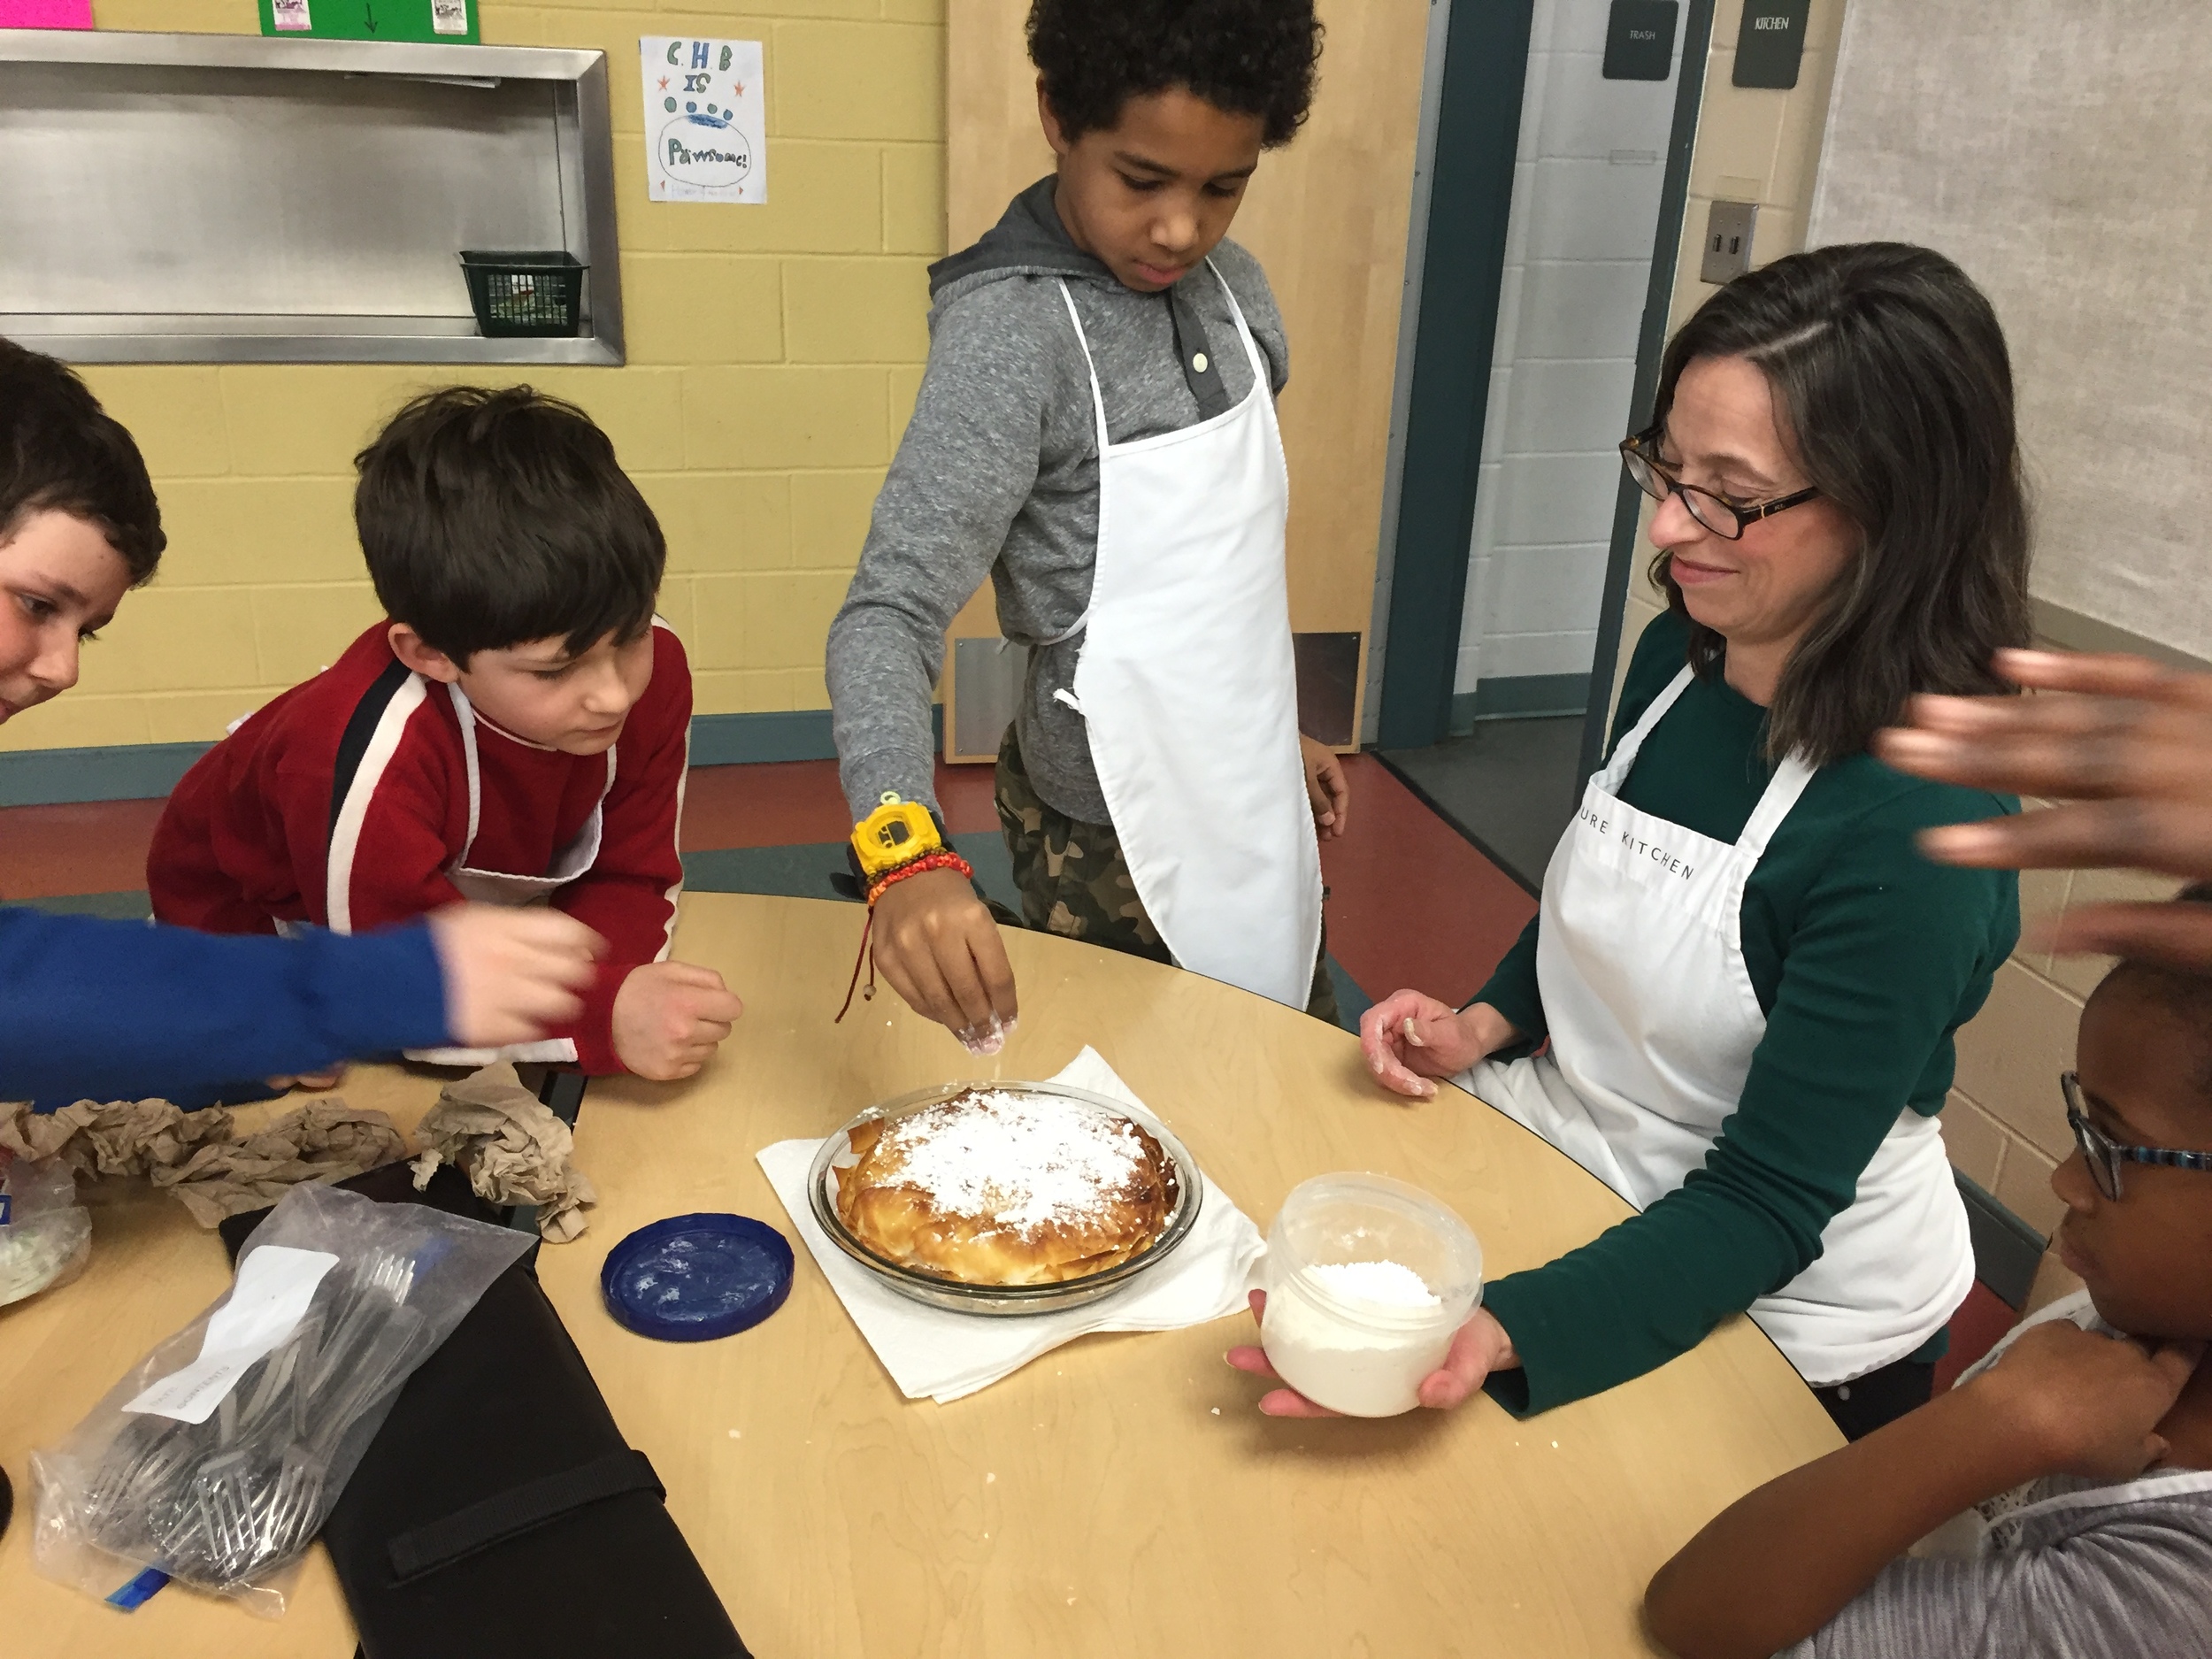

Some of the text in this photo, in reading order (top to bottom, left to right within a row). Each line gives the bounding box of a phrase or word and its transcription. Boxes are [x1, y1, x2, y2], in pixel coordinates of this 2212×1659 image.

[1755, 17, 1789, 30] KITCHEN
[1630, 30, 1655, 41] TRASH
[683, 73, 711, 93] IS
[1621, 831, 1694, 880] KITCHEN
